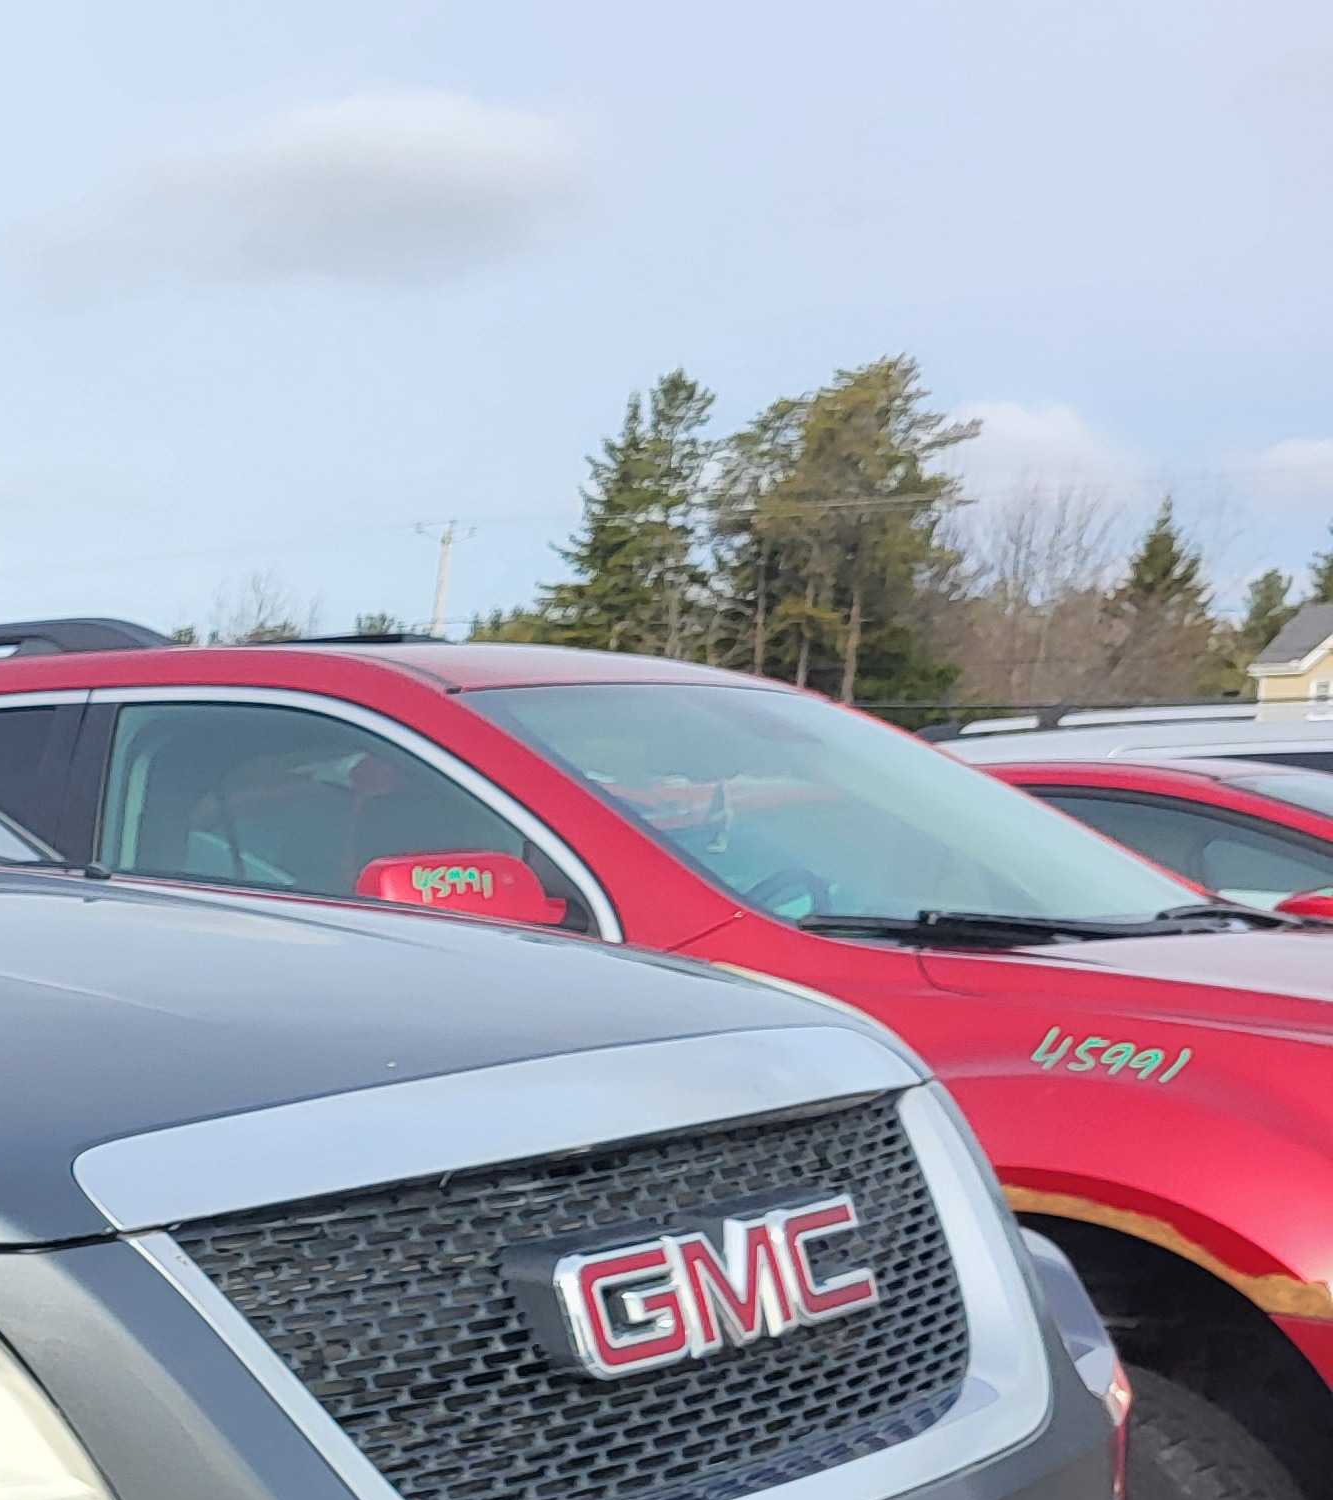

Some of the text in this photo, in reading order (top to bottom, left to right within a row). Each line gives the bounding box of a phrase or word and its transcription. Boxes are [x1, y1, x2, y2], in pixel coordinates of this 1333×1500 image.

[412, 865, 493, 904] 45991
[1030, 1025, 1192, 1084] 45991
[553, 1193, 880, 1382] GMC
